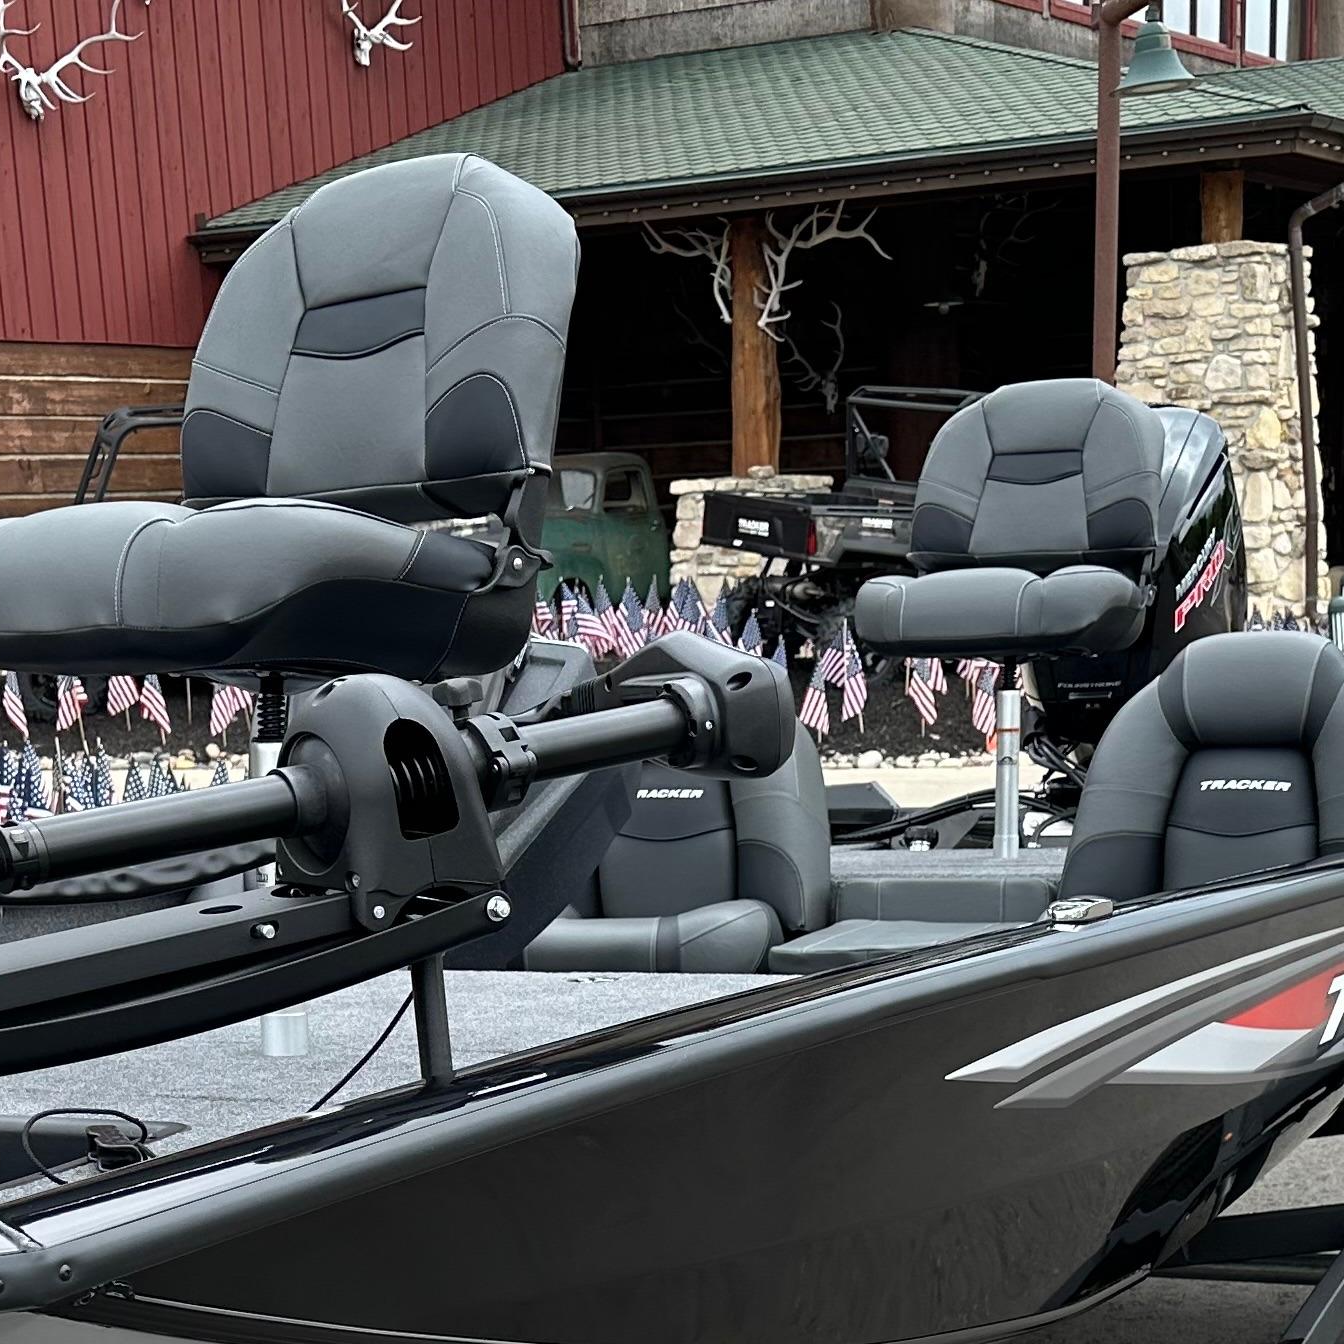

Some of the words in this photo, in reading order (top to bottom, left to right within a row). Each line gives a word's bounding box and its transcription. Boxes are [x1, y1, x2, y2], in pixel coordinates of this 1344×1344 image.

[1174, 539, 1225, 633] PRO
[1175, 527, 1216, 602] MERCURY
[636, 788, 705, 799] RACKER
[1199, 779, 1292, 792] TRACKER
